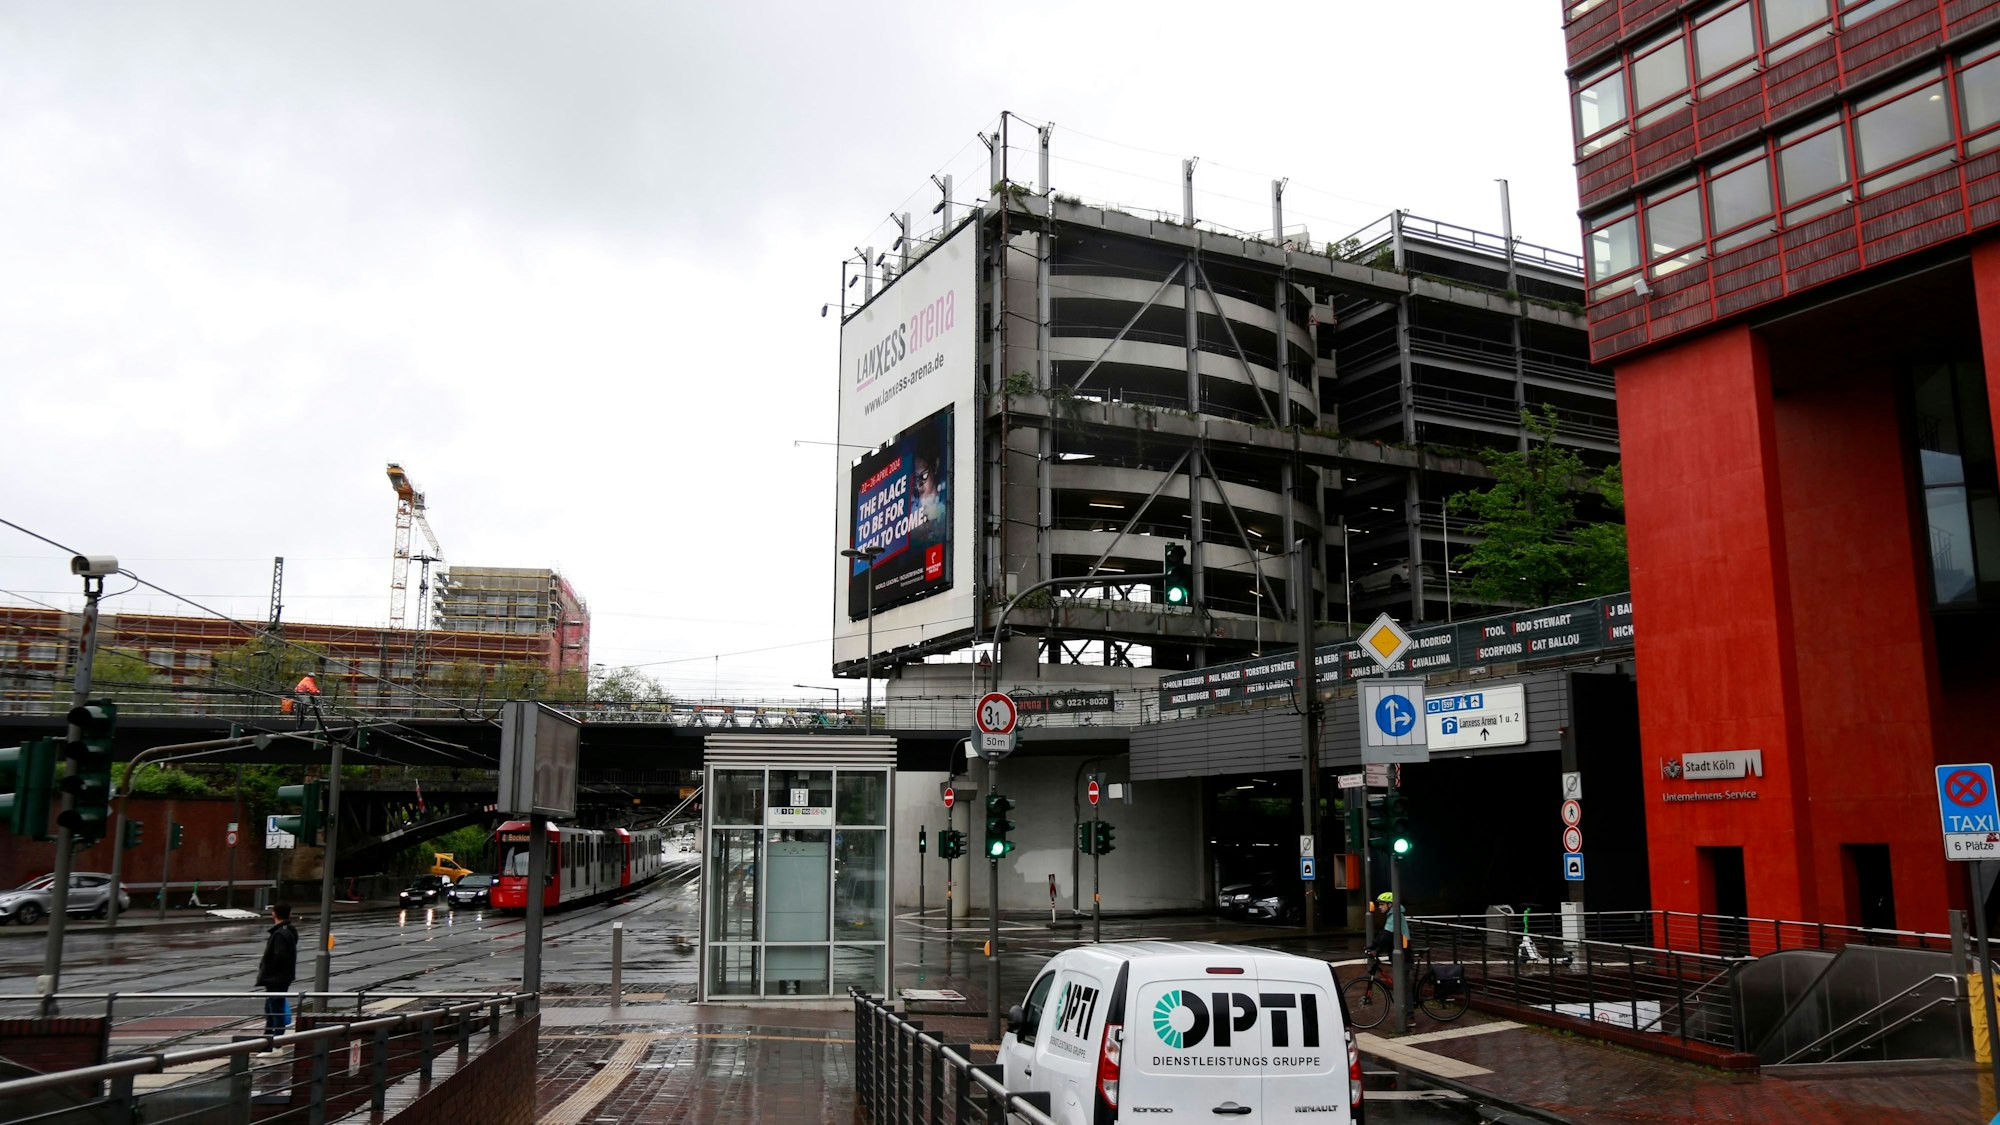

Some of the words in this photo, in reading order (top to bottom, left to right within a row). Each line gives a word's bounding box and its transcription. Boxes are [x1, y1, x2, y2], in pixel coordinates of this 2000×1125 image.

[857, 322, 906, 384] LANXESS
[910, 289, 954, 354] arena
[864, 352, 944, 416] www.lanxess-arena.de
[859, 498, 876, 521] THE
[878, 475, 907, 510] PLACE
[858, 520, 870, 541] TO
[872, 514, 883, 534] BE
[885, 498, 905, 526] FOR
[881, 526, 894, 548] TO
[894, 506, 927, 537] COME.
[1609, 605, 1615, 617] J
[1515, 621, 1532, 633] ROD
[1533, 614, 1572, 629] STEWART
[1485, 625, 1505, 637] TOOL
[1420, 634, 1451, 648] RODRIGO
[1531, 638, 1547, 651] CAT
[1548, 634, 1580, 648] BALLOU
[1348, 650, 1360, 660] REA
[1479, 643, 1522, 659] SCORPIONS
[1323, 653, 1339, 664] BERG
[1412, 654, 1451, 668] CAVALLUNA
[1209, 673, 1221, 683] PAUL
[1221, 669, 1240, 681] PANZER
[1246, 665, 1270, 677] TORSTEN
[1270, 661, 1295, 673] STRÄTER
[1350, 666, 1370, 678] JONAS
[1172, 694, 1187, 704] HAZEL
[1187, 691, 1209, 701] BRUGGER
[1215, 687, 1231, 697] TEDDY
[1019, 700, 1042, 710] arena
[1067, 698, 1109, 707] 0221-8020
[1460, 718, 1480, 728] Lanxess
[1481, 716, 1497, 726] Arena
[1514, 713, 1519, 722] 2
[1685, 761, 1711, 772] Stadt
[1713, 759, 1735, 771] Köln
[1662, 789, 1757, 802] Unternehmens-Service
[1949, 815, 1994, 831] TAXI
[1954, 842, 1961, 851] 6
[1966, 841, 1994, 851] Plätze
[1055, 981, 1100, 1041] OPTI
[1153, 989, 1320, 1049] OPTI
[1153, 1056, 1268, 1067] DIENSTLEISTUNGS
[1272, 1056, 1320, 1067] GRUPPE
[1294, 1105, 1339, 1113] RENAULT
